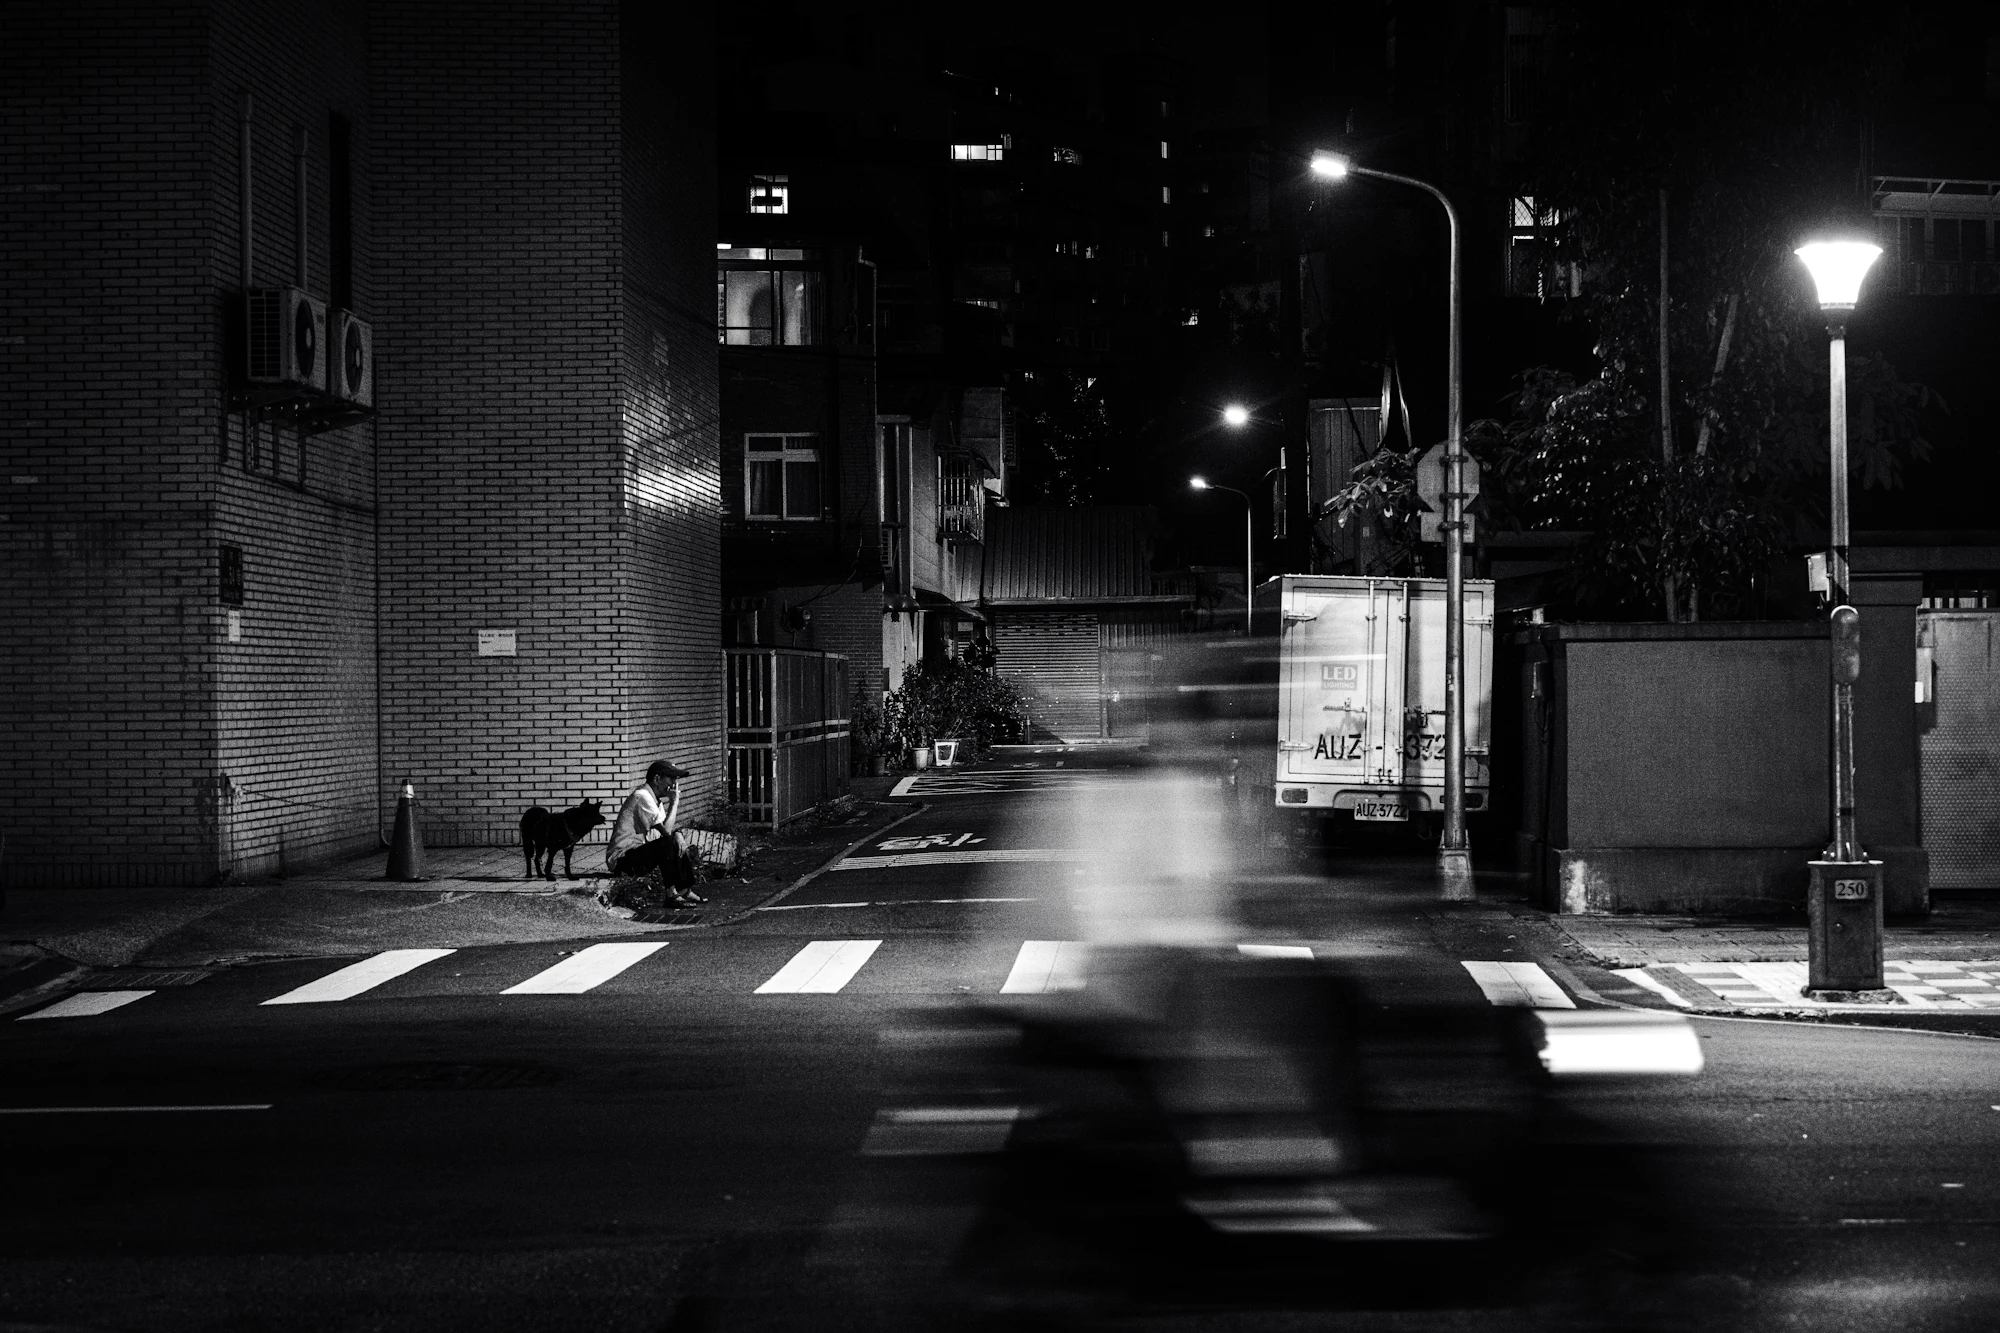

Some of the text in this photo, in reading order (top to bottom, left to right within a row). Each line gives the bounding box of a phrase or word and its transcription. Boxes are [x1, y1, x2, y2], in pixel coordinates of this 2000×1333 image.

[1323, 666, 1356, 680] LED
[1314, 733, 1362, 760] AUZ
[1837, 882, 1864, 896] 250
